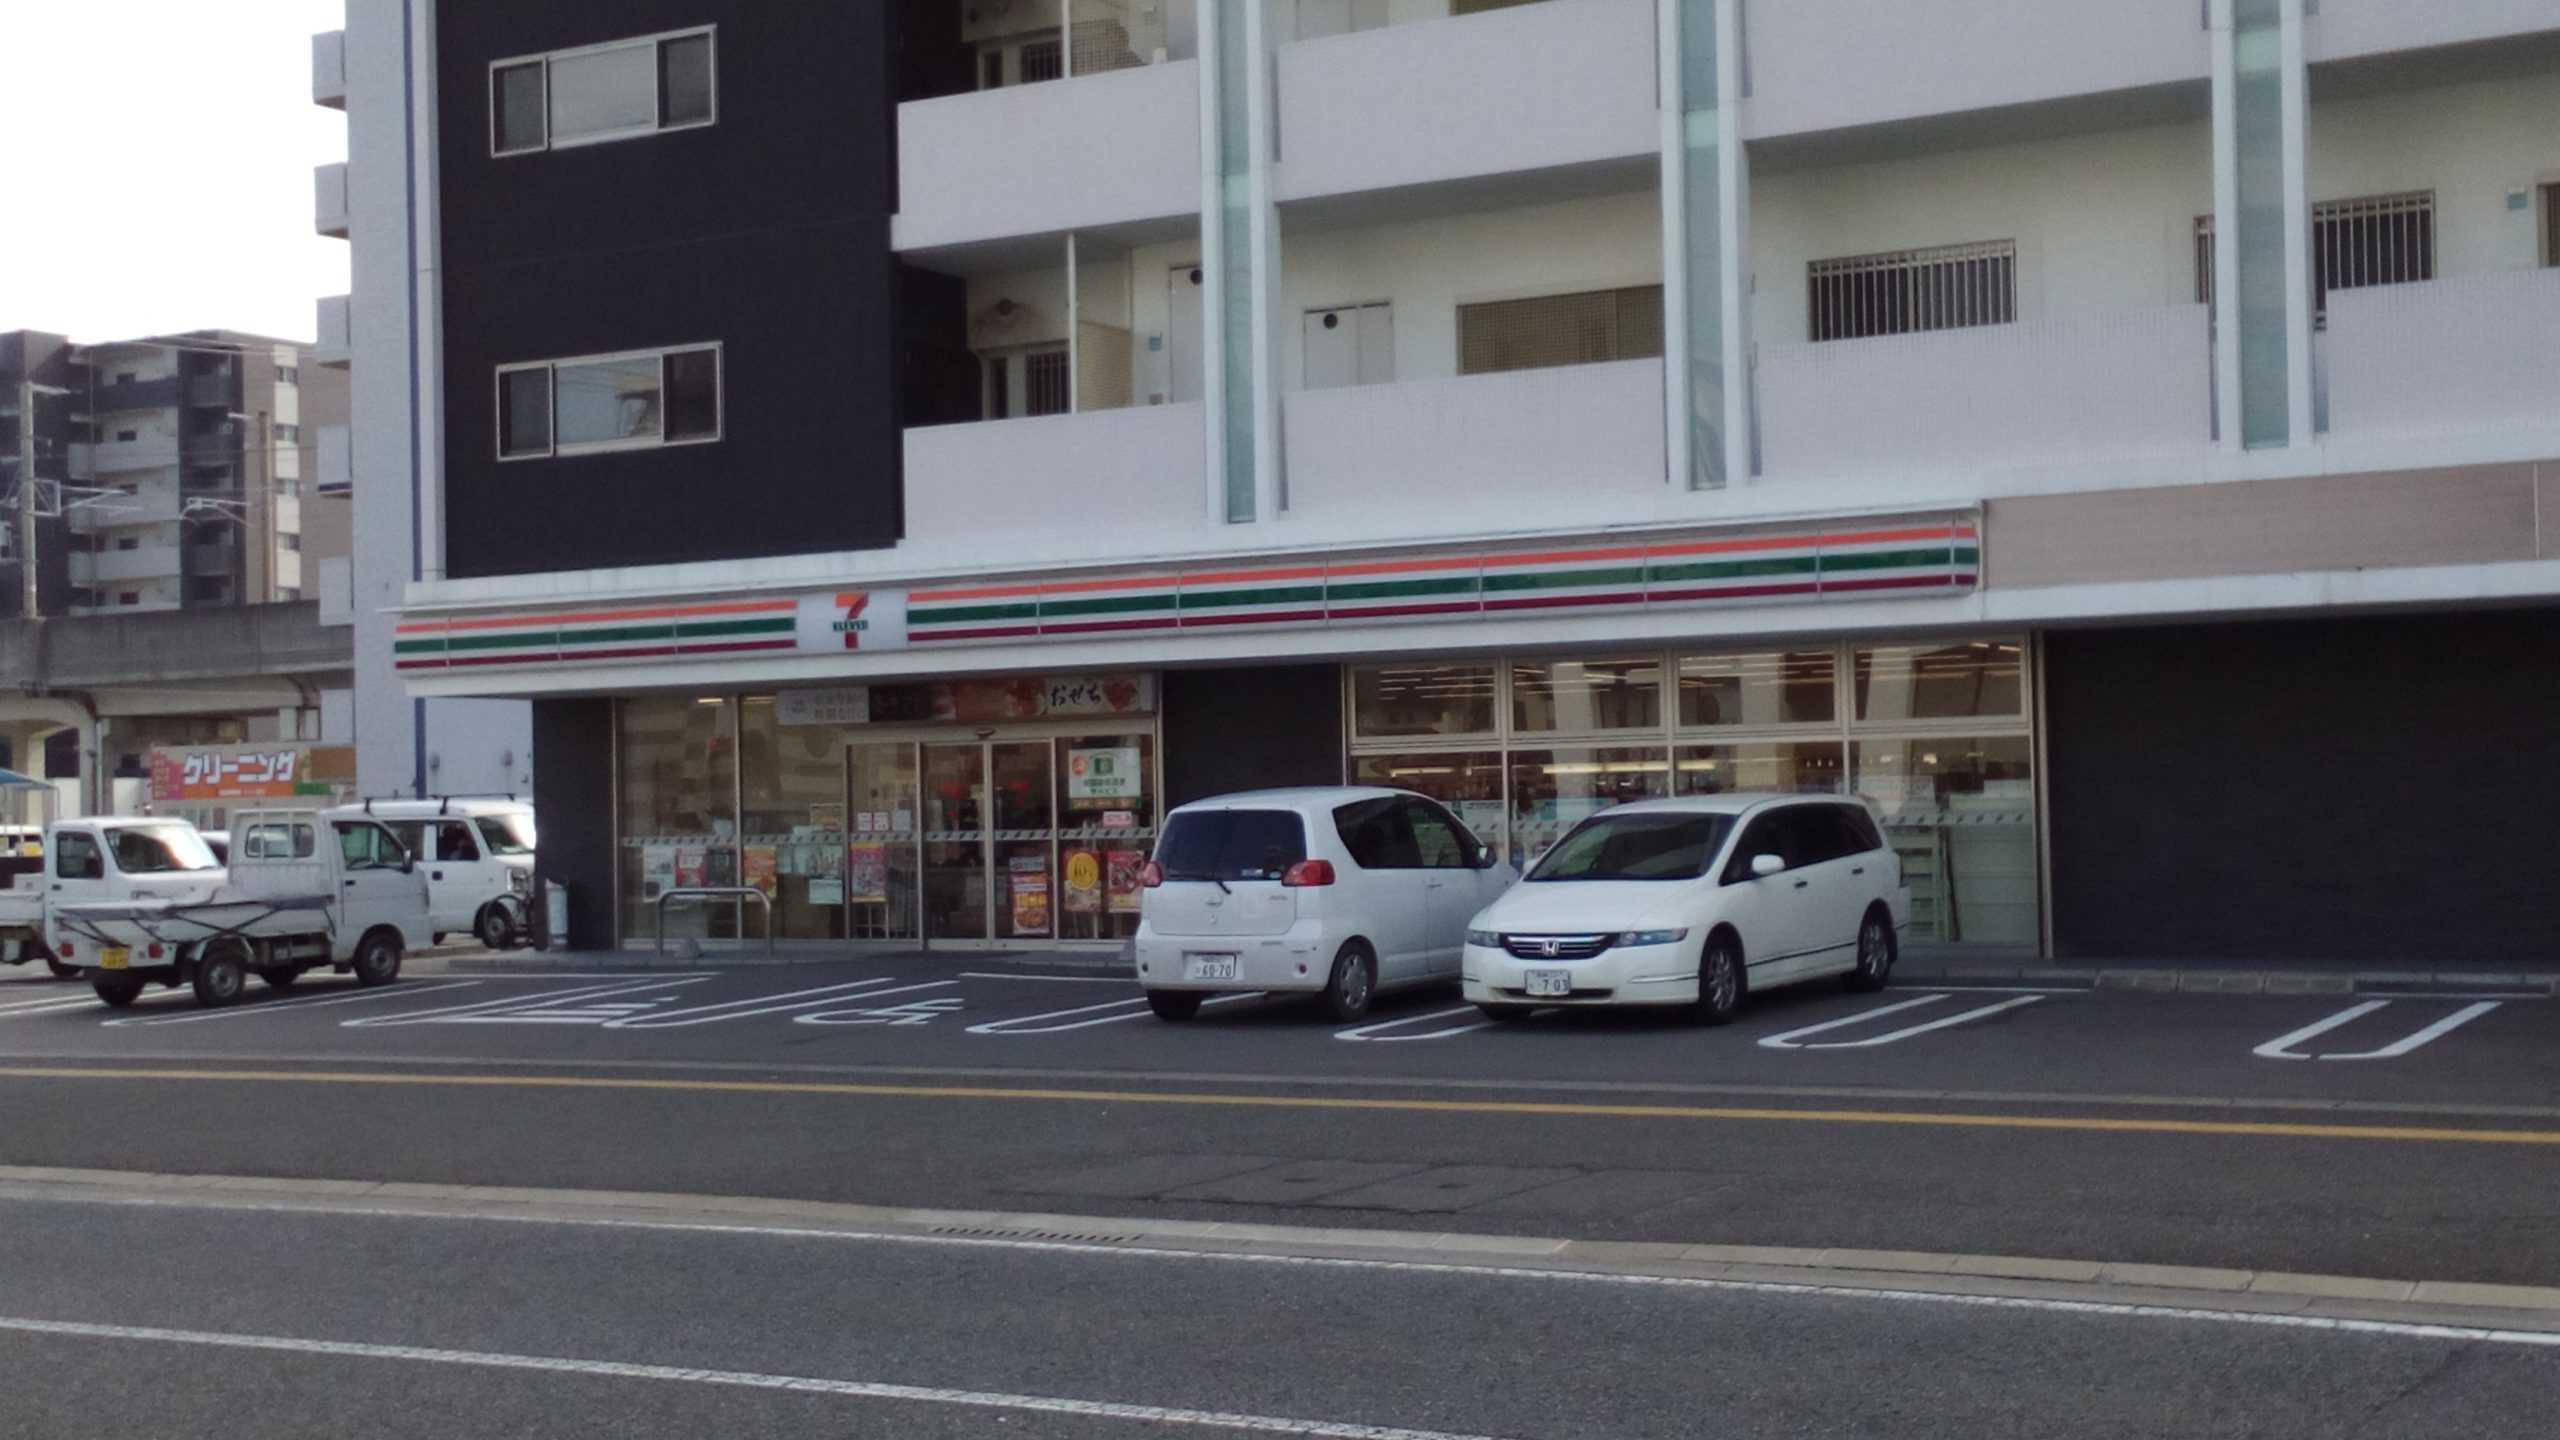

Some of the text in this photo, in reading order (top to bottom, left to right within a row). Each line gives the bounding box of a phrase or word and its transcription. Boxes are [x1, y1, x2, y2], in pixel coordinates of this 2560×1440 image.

[834, 592, 870, 649] 7
[1051, 682, 1101, 707] おせち
[183, 750, 297, 785] クリーニング
